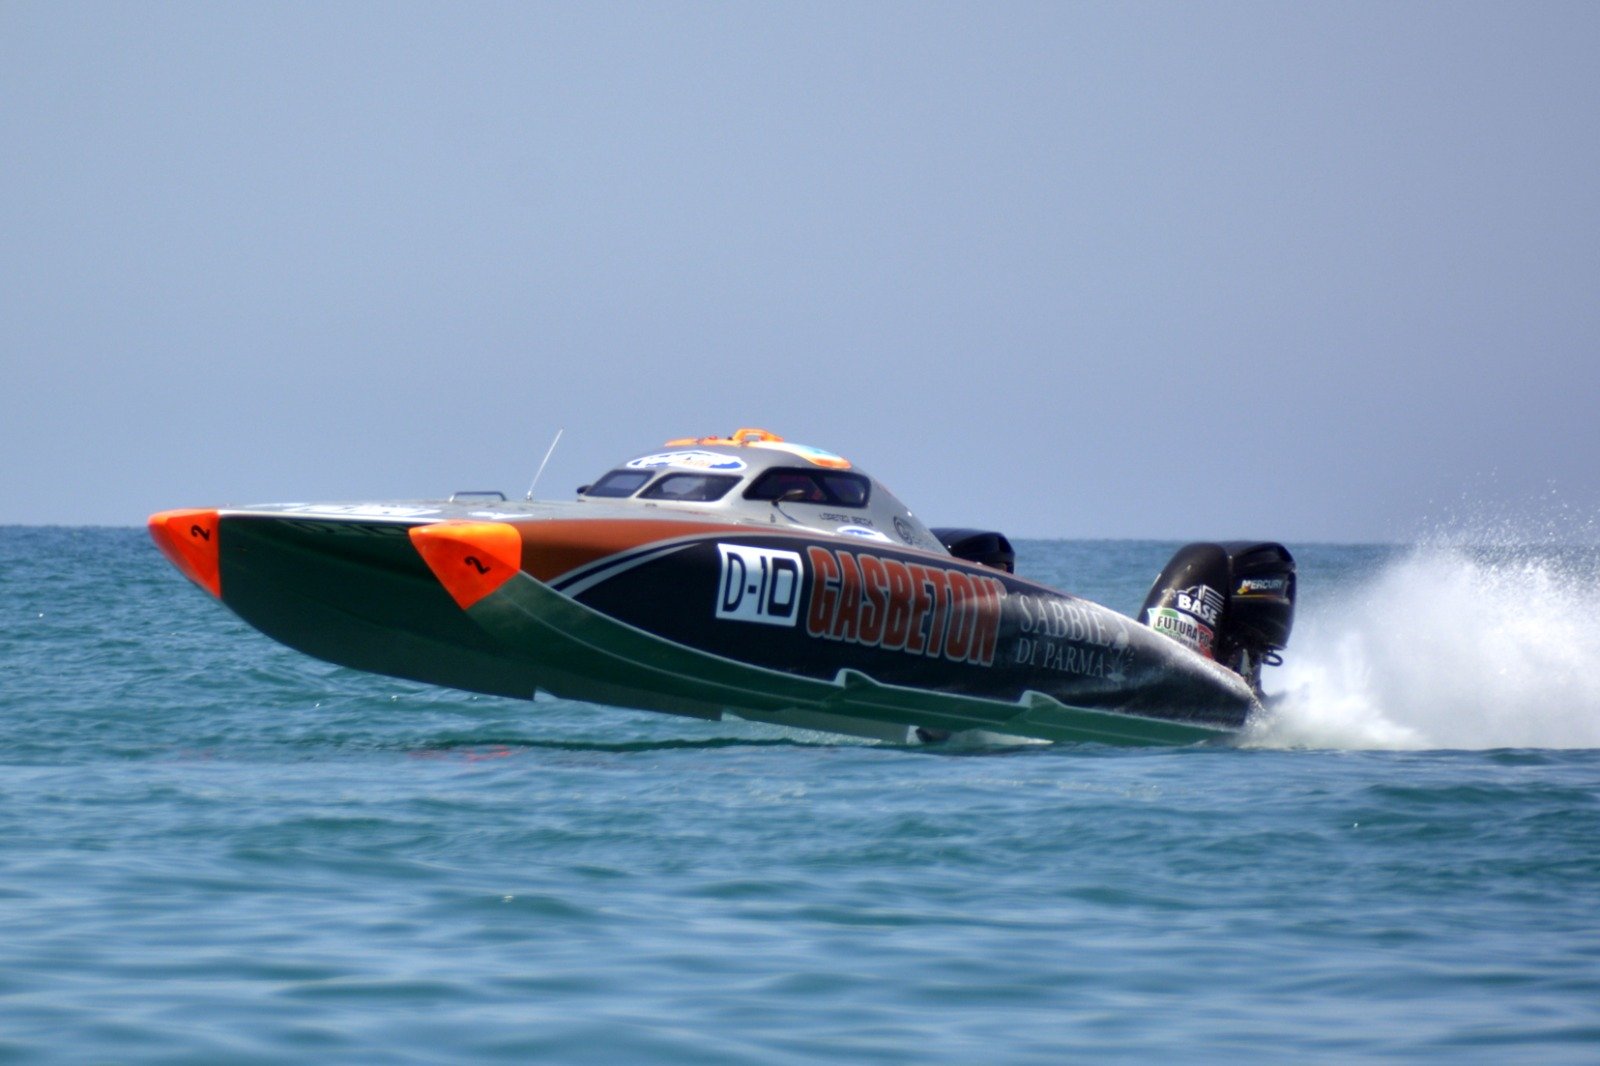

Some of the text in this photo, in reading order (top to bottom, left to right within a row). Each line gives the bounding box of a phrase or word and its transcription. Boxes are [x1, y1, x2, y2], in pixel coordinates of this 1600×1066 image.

[191, 524, 211, 542] 2
[464, 555, 491, 575] 2
[722, 551, 799, 618] D-10
[1239, 579, 1283, 591] MERCURY
[806, 545, 1003, 667] GASBETON
[1020, 595, 1111, 647] SABBIE
[1178, 594, 1217, 626] BASE
[1157, 616, 1198, 642] FUTURA
[1015, 638, 1104, 678] DI PARMA
